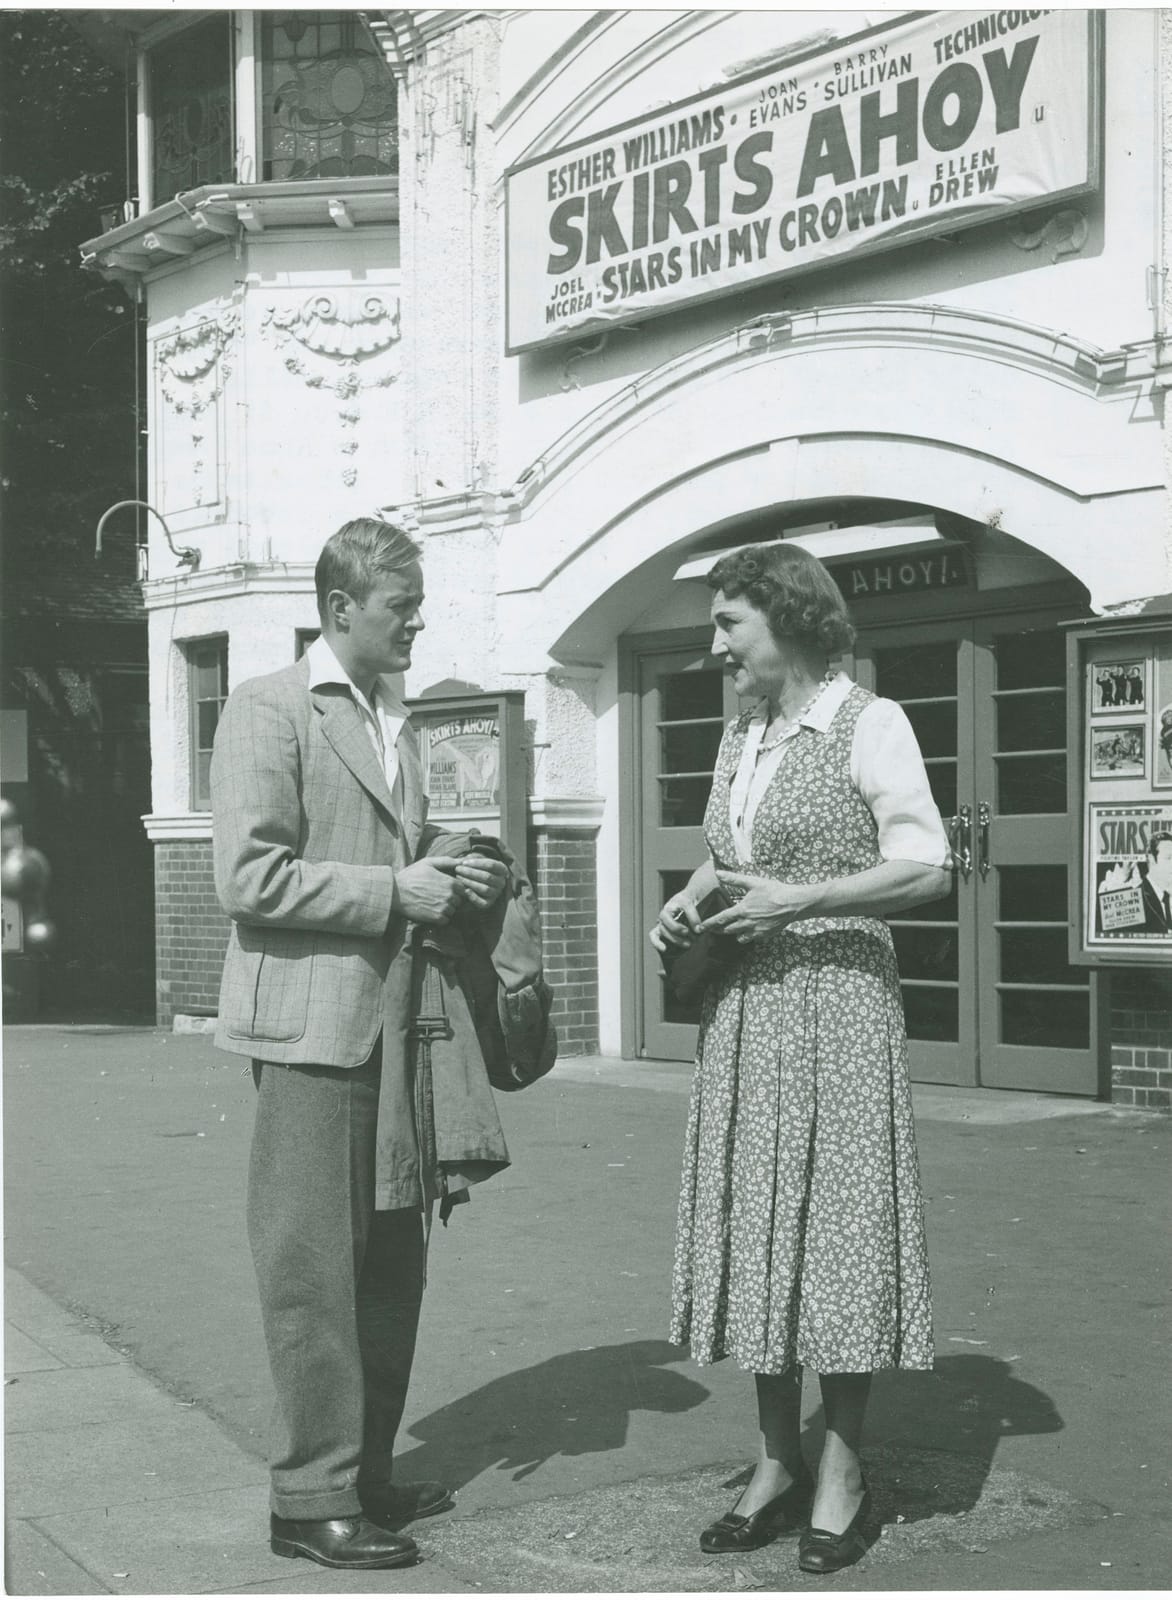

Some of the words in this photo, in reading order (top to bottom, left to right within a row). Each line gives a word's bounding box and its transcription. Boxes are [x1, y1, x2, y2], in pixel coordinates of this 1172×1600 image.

[933, 10, 1056, 65] TECHNICOL
[824, 53, 913, 102] SULLIVAN
[833, 44, 889, 75] BARRY
[759, 77, 799, 104] JOAN
[750, 91, 807, 129] EVANS
[546, 130, 774, 275] SKIRTS
[796, 34, 1041, 199] AHOY
[547, 148, 617, 202] ESTHER
[622, 105, 726, 173] WILLIAMS
[935, 147, 996, 181] ELLEN
[928, 166, 1000, 207] DREW
[601, 246, 683, 304] STARS
[690, 234, 721, 279] IN
[728, 216, 772, 269] MY
[779, 175, 909, 251] CROWN
[550, 276, 585, 301] JOEL
[430, 719, 462, 746] SKIRTS
[1100, 821, 1148, 855] STARS
